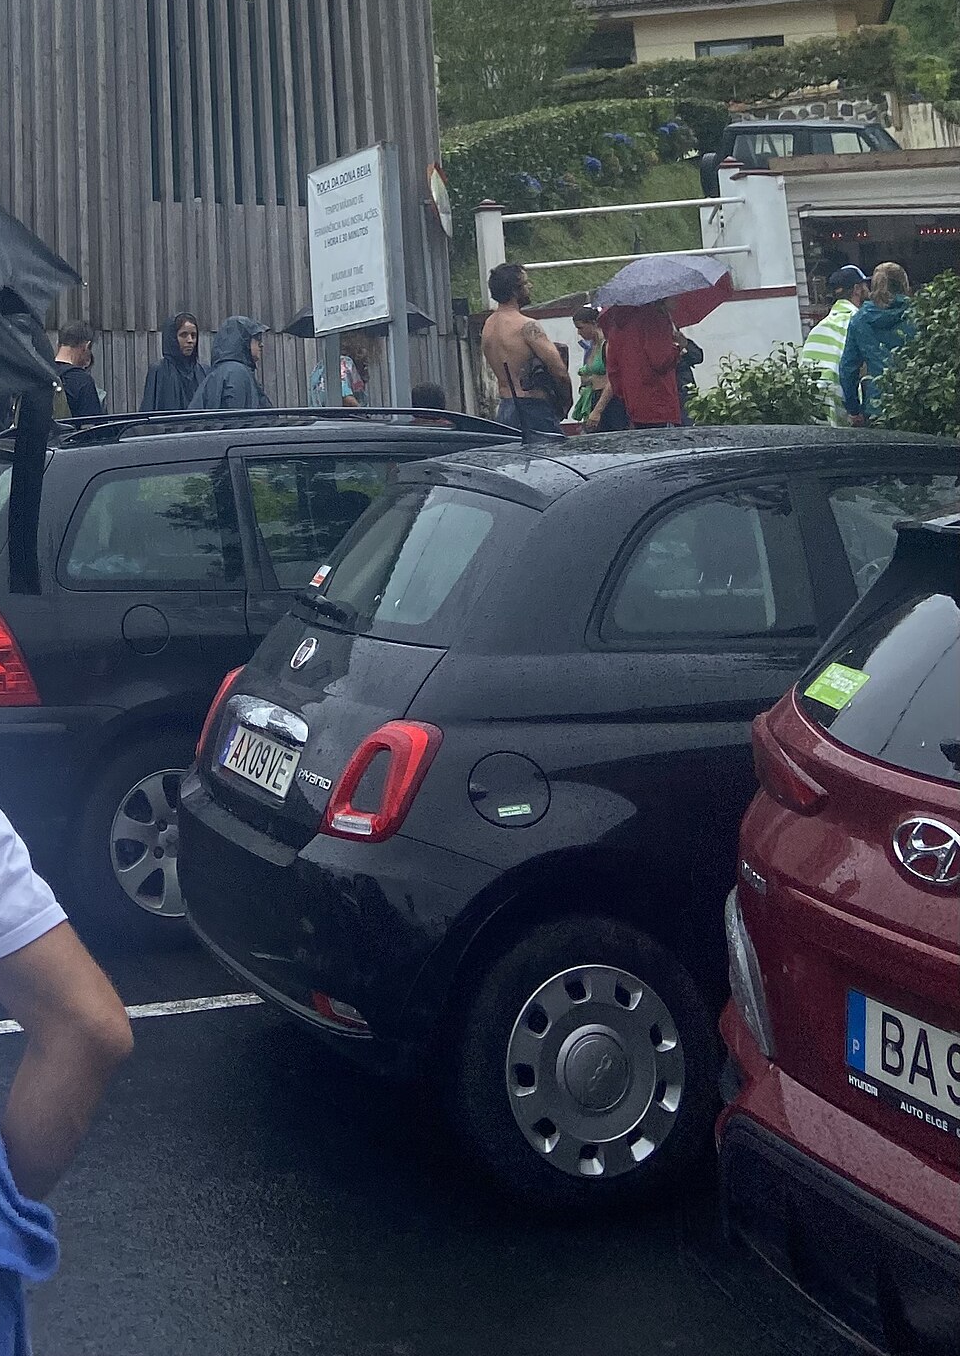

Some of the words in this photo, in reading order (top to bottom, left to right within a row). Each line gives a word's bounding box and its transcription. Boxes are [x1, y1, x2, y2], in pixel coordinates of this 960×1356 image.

[331, 176, 340, 189] DA
[340, 170, 356, 185] DONA
[327, 236, 339, 247] HORA
[348, 226, 369, 240] MINUTOS
[353, 264, 364, 275] TIME
[327, 304, 340, 315] HOUR
[355, 295, 376, 309] MINUTES
[229, 732, 294, 790] AX09VE
[298, 768, 332, 791] HYBRID
[852, 1038, 860, 1055] P
[848, 1074, 879, 1097] HYUNDAI
[900, 1101, 924, 1120] AUTO
